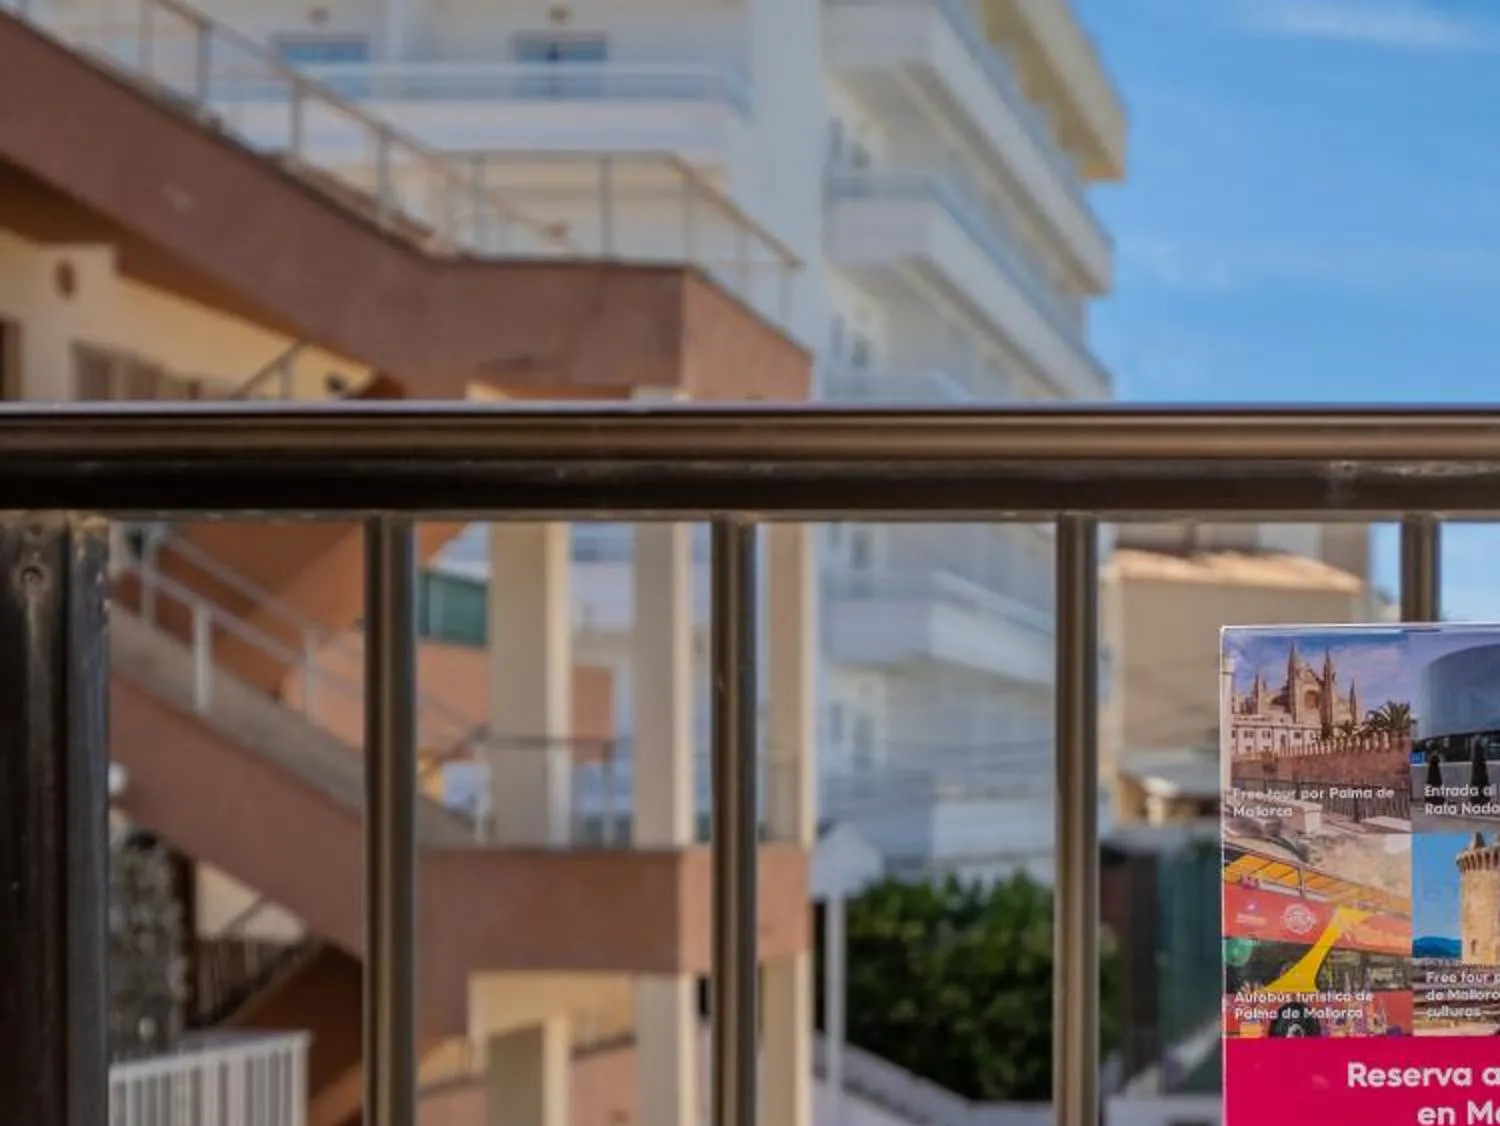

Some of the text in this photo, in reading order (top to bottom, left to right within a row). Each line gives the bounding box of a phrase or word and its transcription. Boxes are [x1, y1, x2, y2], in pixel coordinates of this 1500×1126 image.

[1300, 790, 1325, 802] por
[1329, 787, 1373, 799] Palma
[1376, 786, 1395, 798] de
[1424, 784, 1478, 797] Entrada
[1233, 805, 1293, 817] Mallorca
[1424, 803, 1457, 815] Rafa
[1425, 971, 1457, 983] Free
[1461, 971, 1490, 983] tour
[1355, 991, 1374, 1002] de
[1425, 989, 1445, 1001] de
[1234, 1007, 1363, 1020] Palma de Mallorca
[1425, 1005, 1482, 1018] culturas
[1346, 1061, 1473, 1088] Reserva
[1416, 1104, 1456, 1126] en
